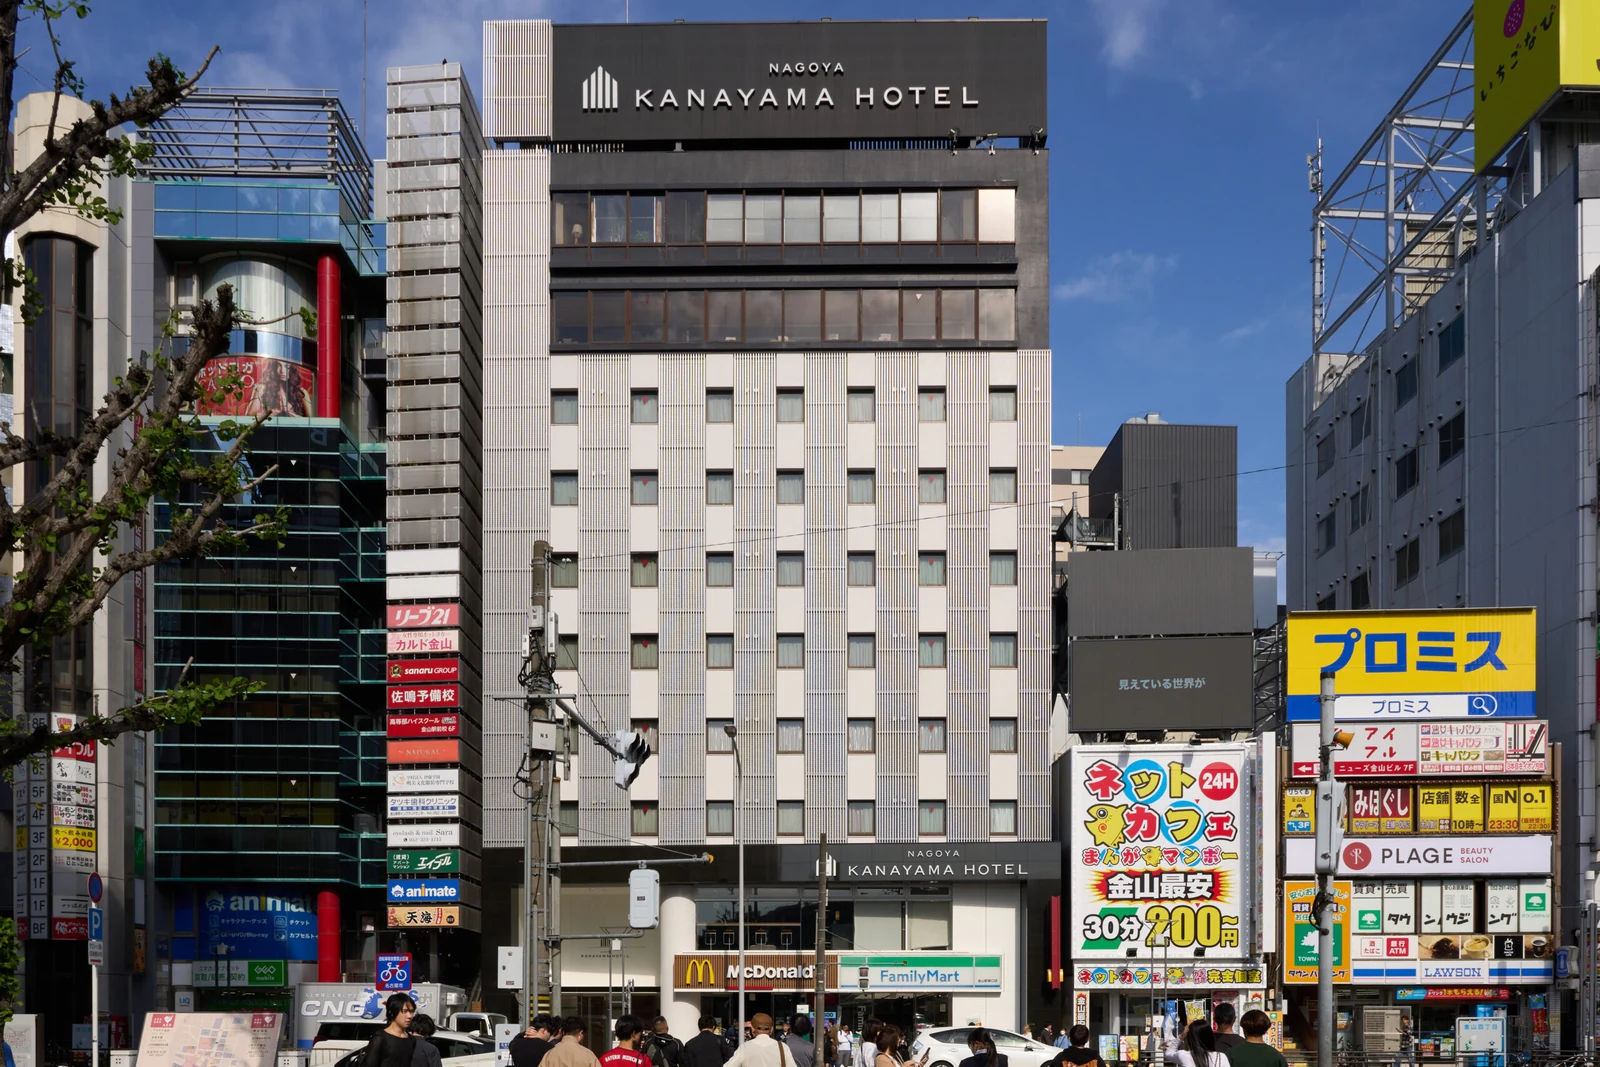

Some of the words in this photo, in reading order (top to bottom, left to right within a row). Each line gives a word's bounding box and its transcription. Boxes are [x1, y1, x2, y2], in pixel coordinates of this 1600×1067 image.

[769, 62, 845, 75] NAGOYA
[635, 86, 835, 108] KANAYAMA
[855, 85, 980, 106] HOTEL
[395, 606, 451, 626] リーブ21
[395, 638, 452, 651] カルド金山
[1314, 628, 1508, 673] プロミス
[1119, 678, 1206, 690] 見えている世界が
[391, 689, 454, 703] 佐鳴予備校
[1372, 700, 1431, 713] プロミス
[1365, 727, 1396, 741] アイ
[1365, 746, 1397, 759] フル
[1431, 750, 1481, 761] キャバクラ
[1339, 765, 1401, 773] ニューズ金山ビル
[1084, 759, 1196, 801] ネット
[1202, 773, 1234, 789] 24H
[32, 786, 45, 798] 5F
[389, 797, 458, 806] タツキ歯科クリニック
[32, 809, 45, 821] 4F
[1123, 803, 1238, 843] カフェ
[1489, 820, 1519, 830] 23:30
[32, 831, 45, 843] 3F
[55, 837, 94, 848] ¥2,000
[907, 850, 960, 858] NAGOYA
[1082, 848, 1139, 865] まんが
[1162, 847, 1239, 866] マンボー
[1381, 847, 1453, 865] PLAGE
[1460, 847, 1494, 855] BEAUTY
[32, 854, 45, 866] 2F
[414, 853, 452, 870] エイブル
[1460, 856, 1489, 864] SALON
[848, 865, 955, 877] KANAYAMA
[964, 863, 1029, 876] HOTEL
[32, 877, 45, 889] 1F
[1107, 872, 1214, 900] 金山最安
[1353, 883, 1408, 895] 賃貸・売買
[406, 883, 457, 897] animate
[32, 899, 45, 911] 1F
[92, 911, 100, 937] P
[406, 911, 433, 924] 天海
[32, 922, 46, 934] BF
[1083, 913, 1144, 942] 30分
[289, 931, 318, 940] カプセルト
[1389, 947, 1407, 955] ATM
[880, 969, 960, 985] FamilyMart
[1078, 968, 1161, 985] ネットカフェ
[1207, 969, 1261, 984] 完全個室
[1288, 969, 1349, 978] タウンハング
[1424, 967, 1482, 977] LAWSON
[301, 1000, 364, 1017] CNG
[1464, 1023, 1498, 1031] 金山四丁目
